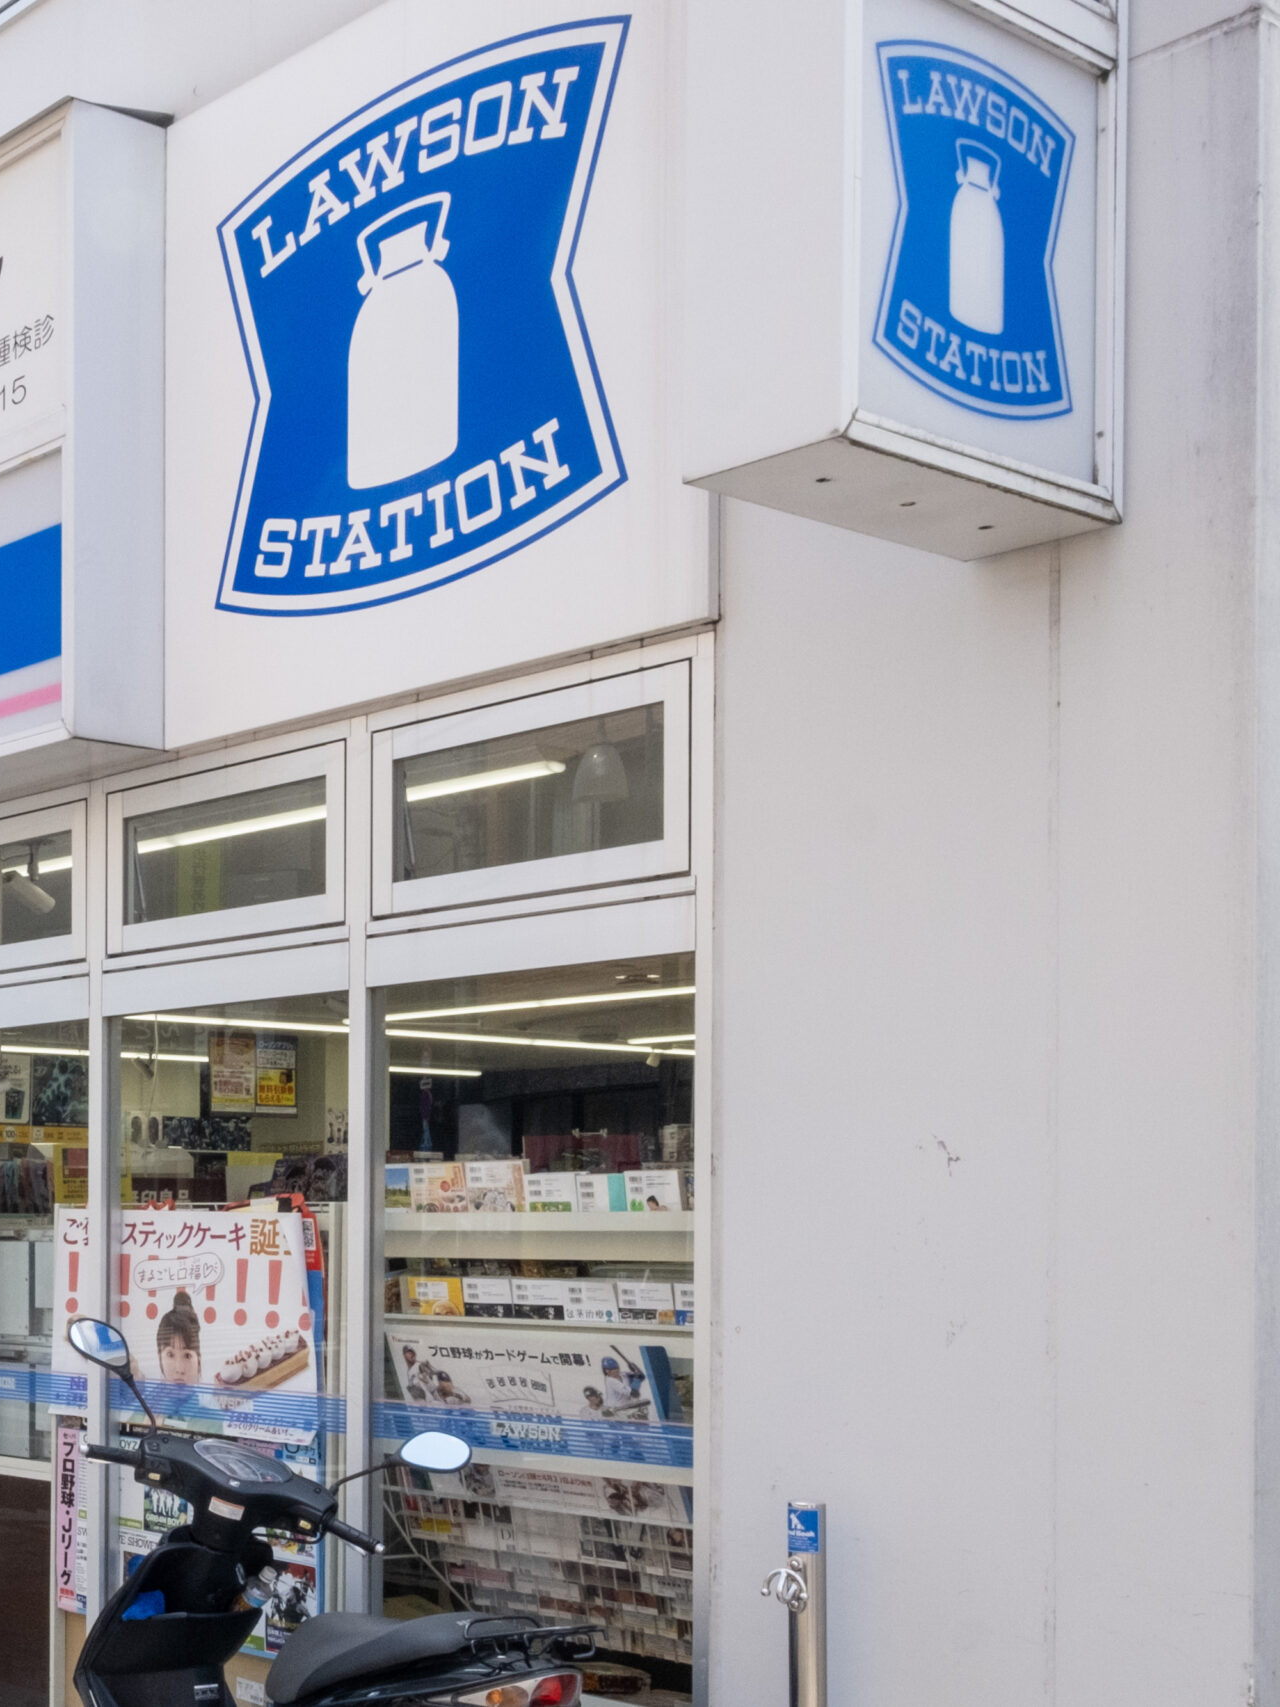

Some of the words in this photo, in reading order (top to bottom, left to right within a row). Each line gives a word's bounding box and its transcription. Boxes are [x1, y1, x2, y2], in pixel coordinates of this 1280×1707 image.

[251, 66, 580, 278] LAWSON
[897, 69, 1055, 178] LAWSON
[896, 299, 1050, 393] STATION
[254, 418, 570, 579] STATION
[121, 1218, 291, 1257] スティックケーキ誕
